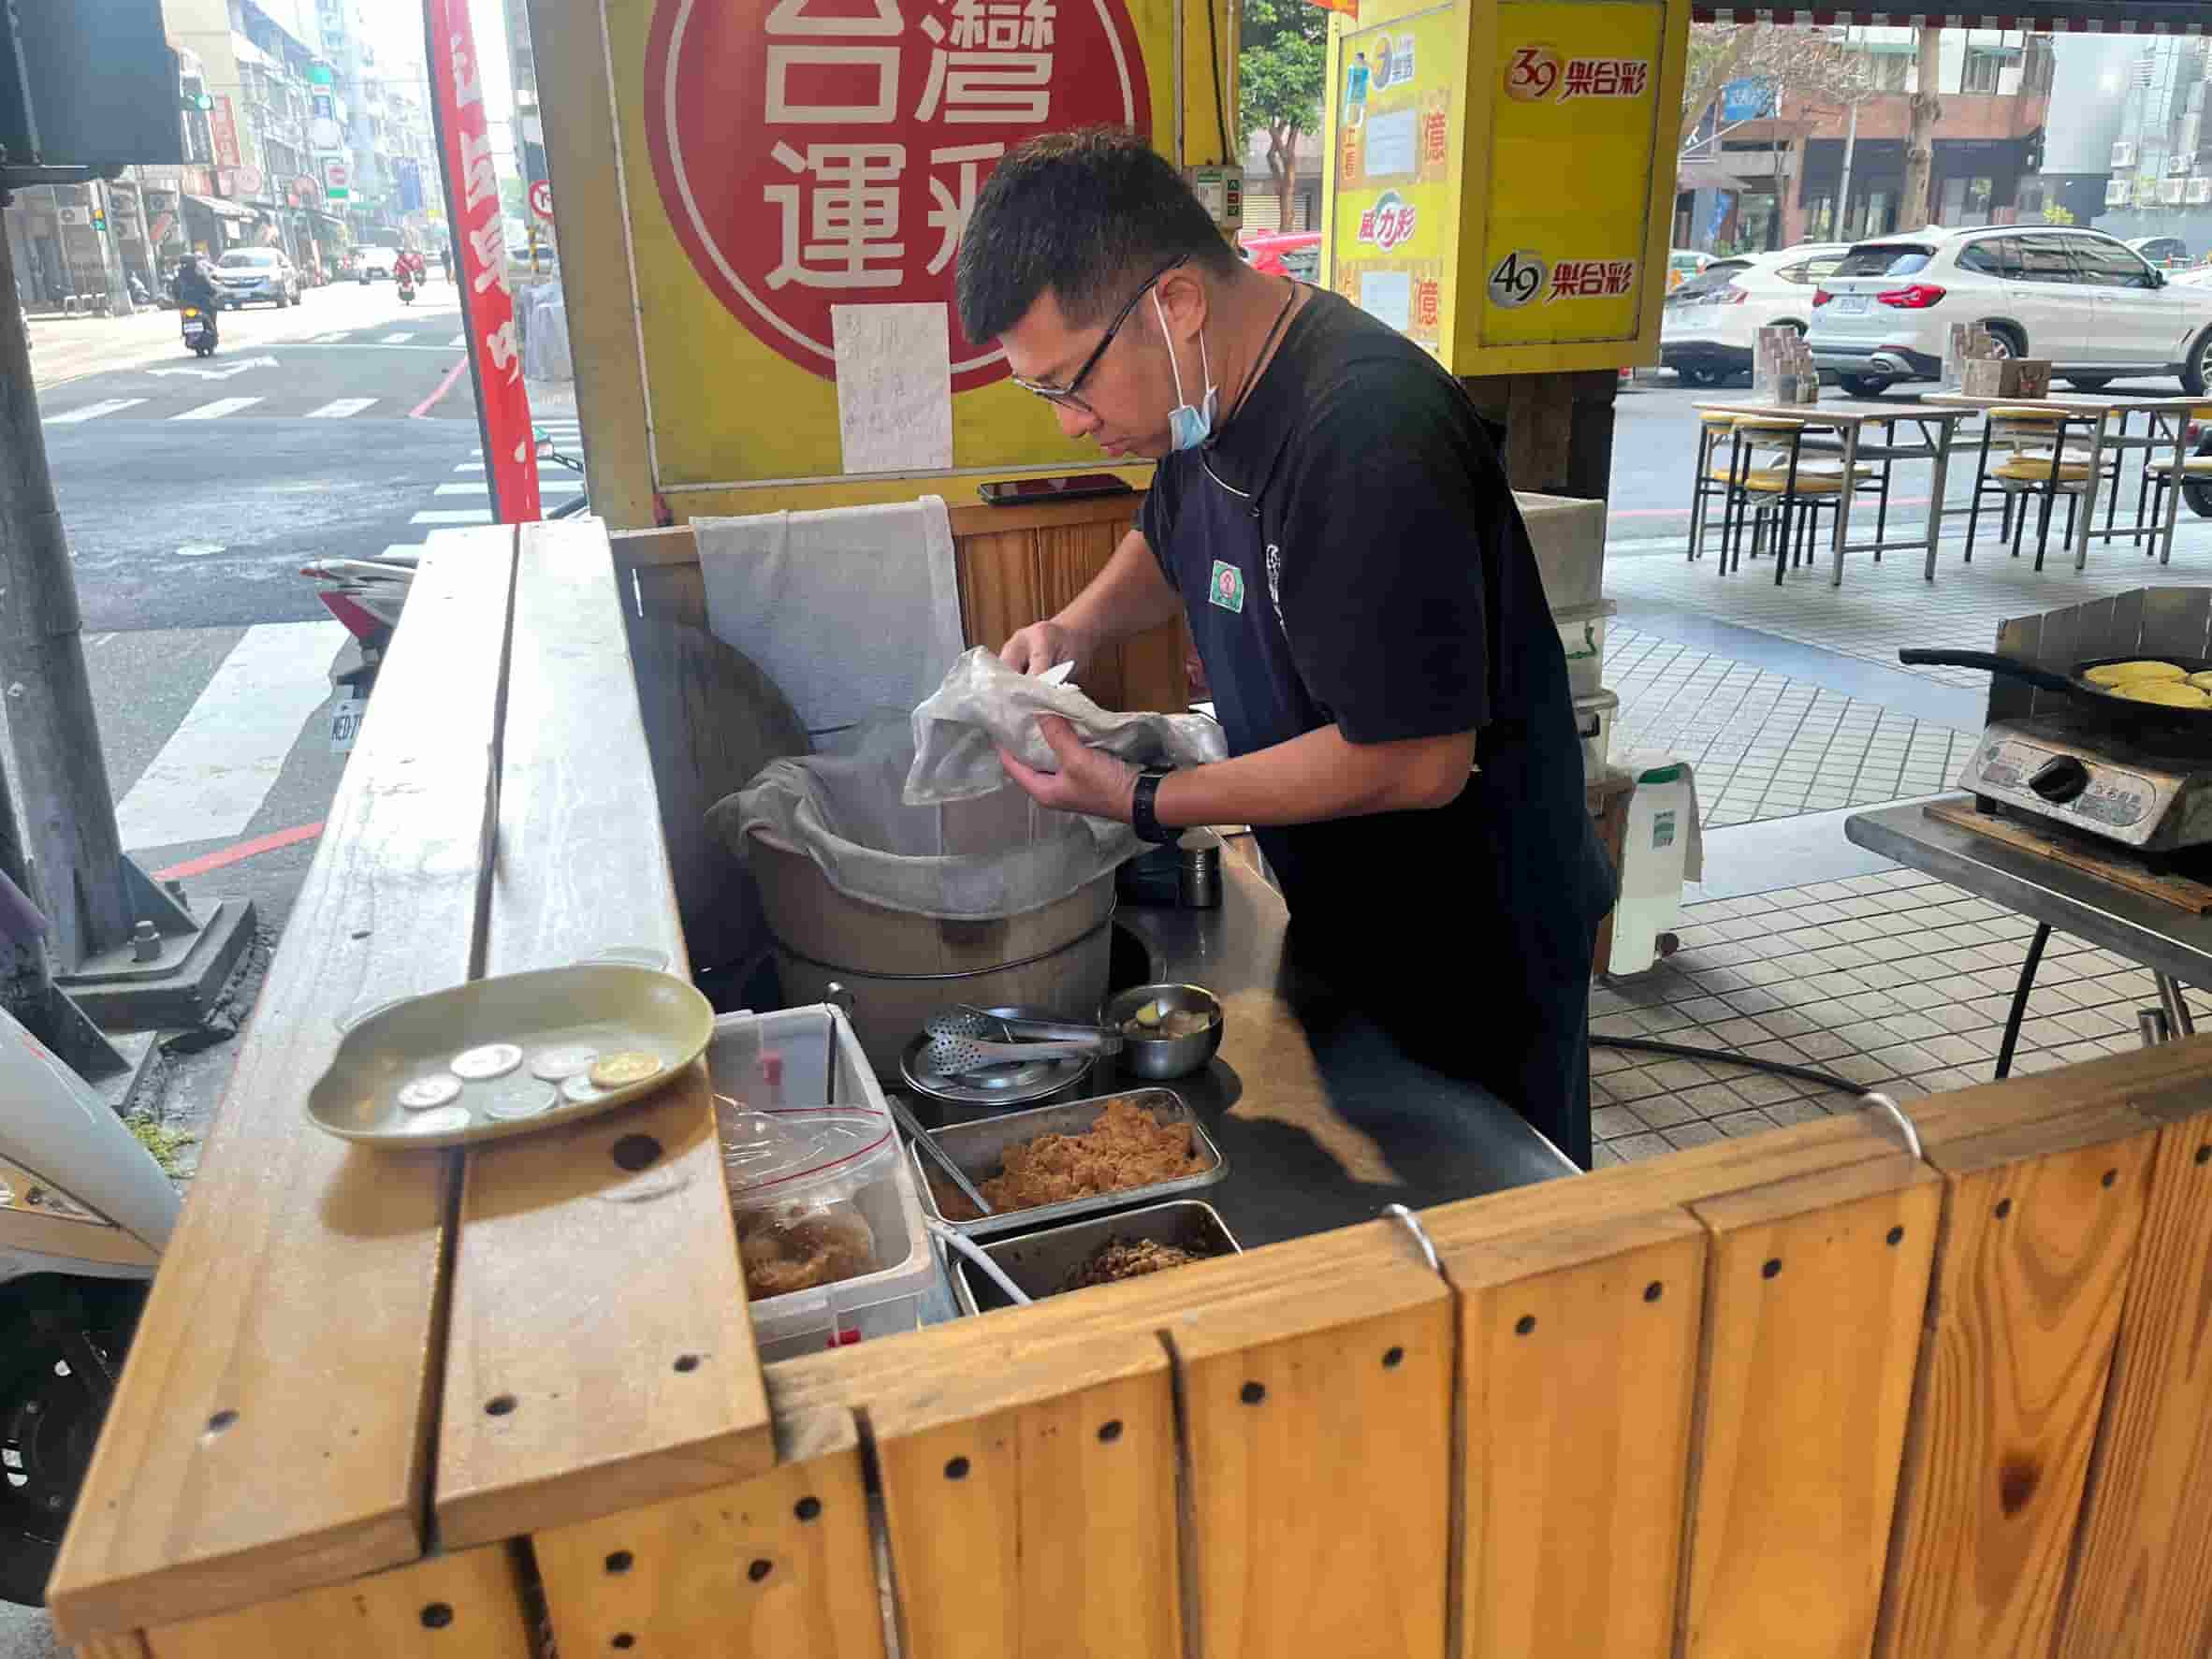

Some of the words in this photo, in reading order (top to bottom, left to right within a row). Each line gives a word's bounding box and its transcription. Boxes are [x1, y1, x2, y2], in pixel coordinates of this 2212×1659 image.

[764, 0, 1056, 124] 台灣
[1510, 48, 1557, 96] 39
[1360, 208, 1416, 248] 威力彩
[1492, 252, 1539, 301] 49
